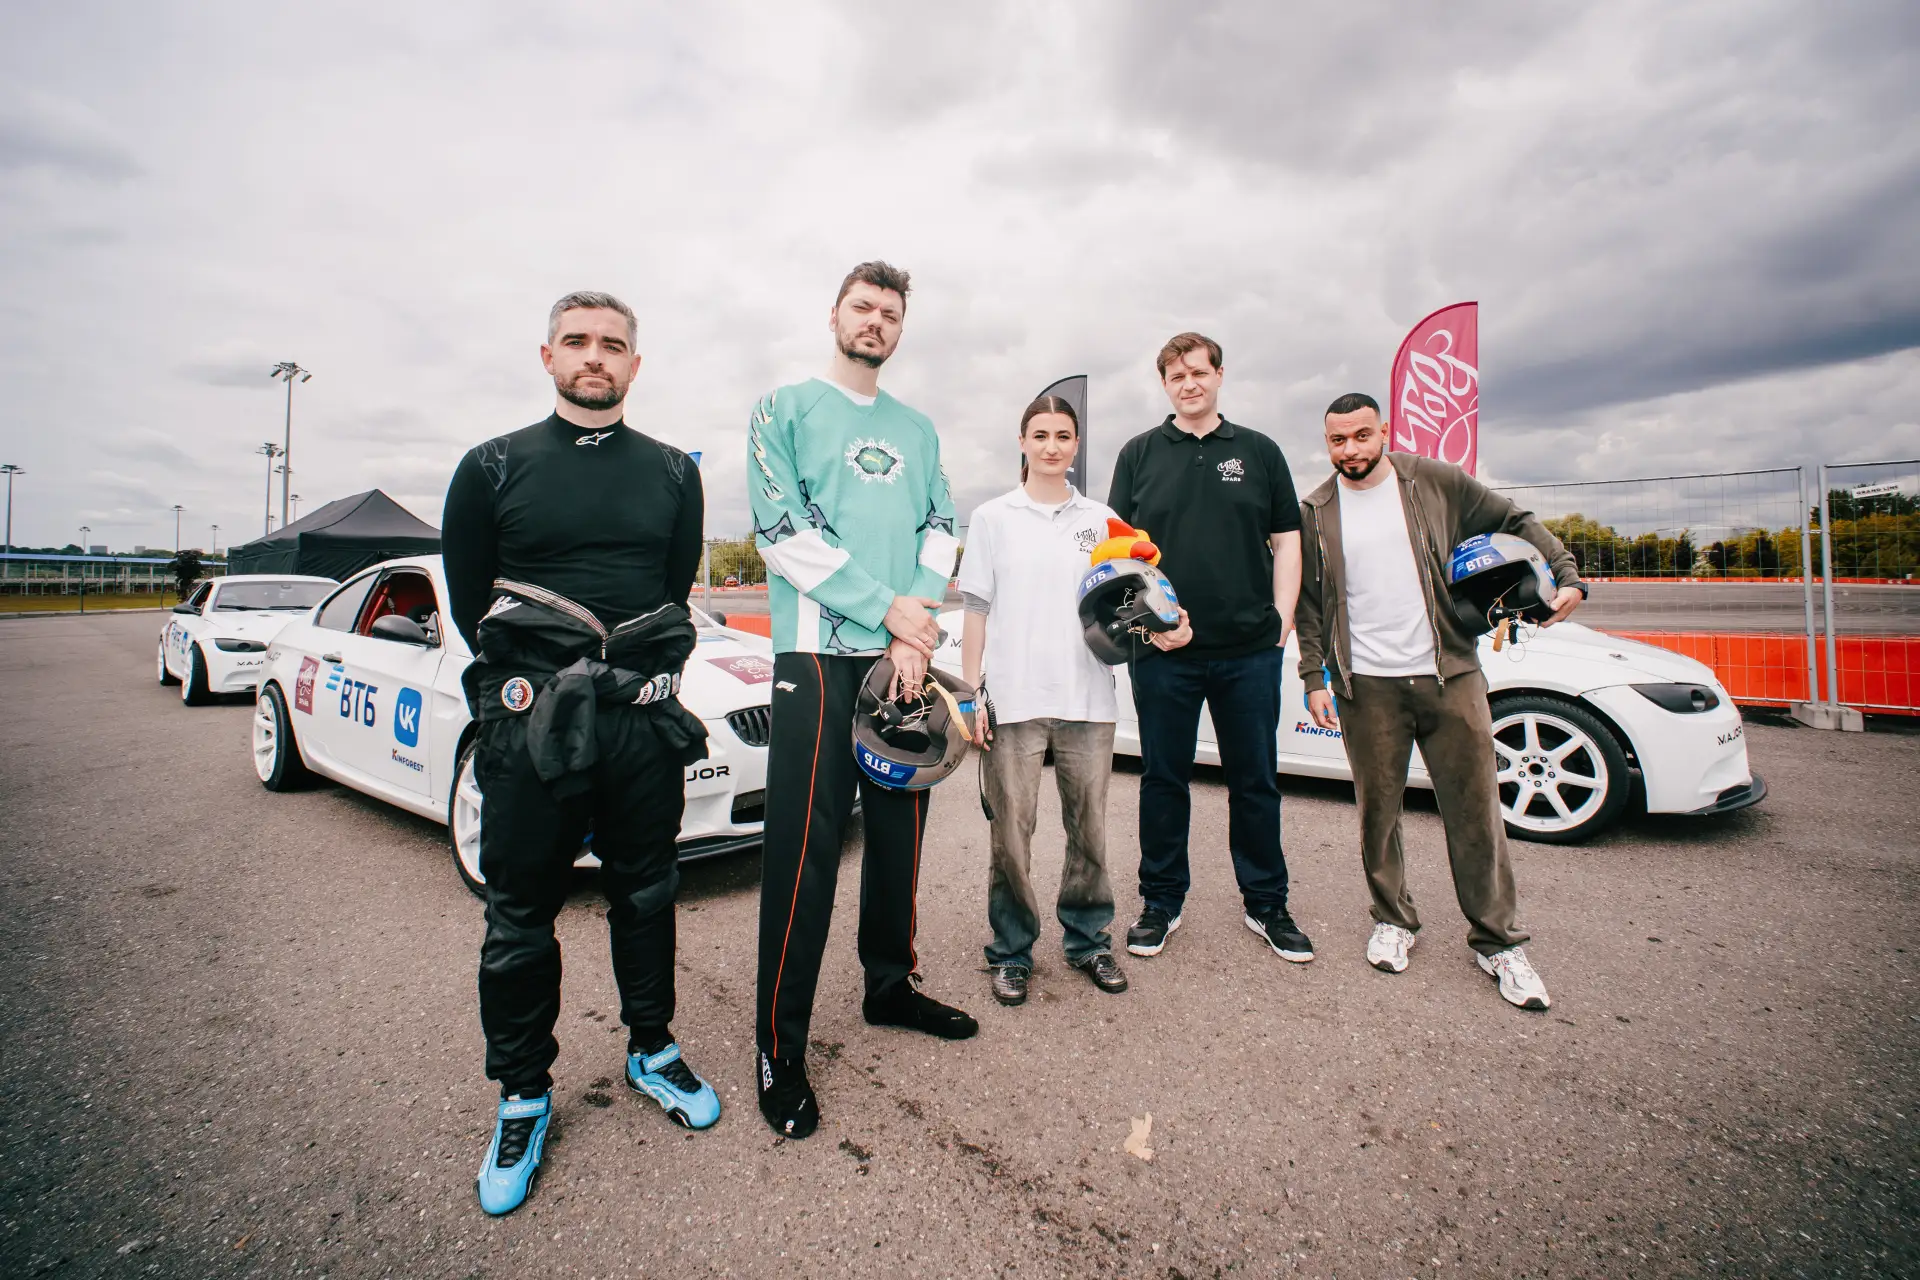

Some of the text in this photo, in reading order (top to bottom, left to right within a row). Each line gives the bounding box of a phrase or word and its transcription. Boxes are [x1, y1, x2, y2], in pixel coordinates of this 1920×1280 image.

[1465, 554, 1493, 572] ВТБ
[1085, 570, 1106, 589] ВТБ
[340, 677, 379, 728] ВТБ
[399, 702, 417, 733] VK
[1294, 721, 1342, 738] KINFOR
[1716, 724, 1743, 746] MAJOR
[392, 748, 424, 773] KINFOREST
[864, 752, 892, 775] ВТБ
[686, 765, 731, 782] JOR
